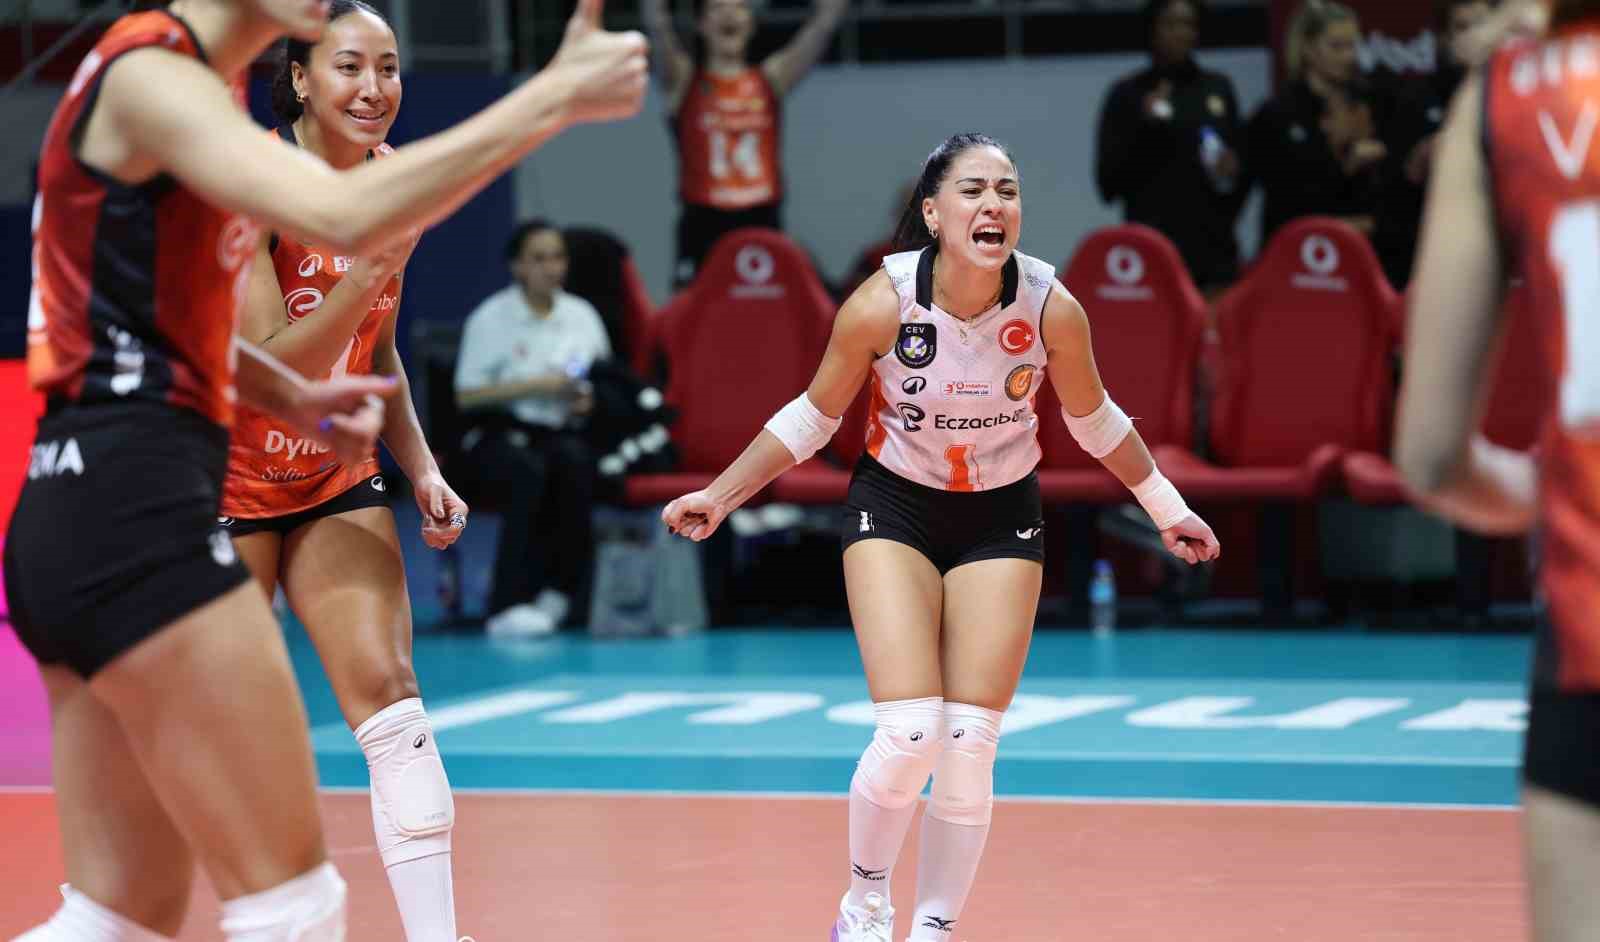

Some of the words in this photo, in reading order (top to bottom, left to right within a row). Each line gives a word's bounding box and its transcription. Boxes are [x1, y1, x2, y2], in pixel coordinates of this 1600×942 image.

[708, 130, 762, 179] 14
[905, 326, 925, 334] CEV
[943, 441, 985, 492] 1
